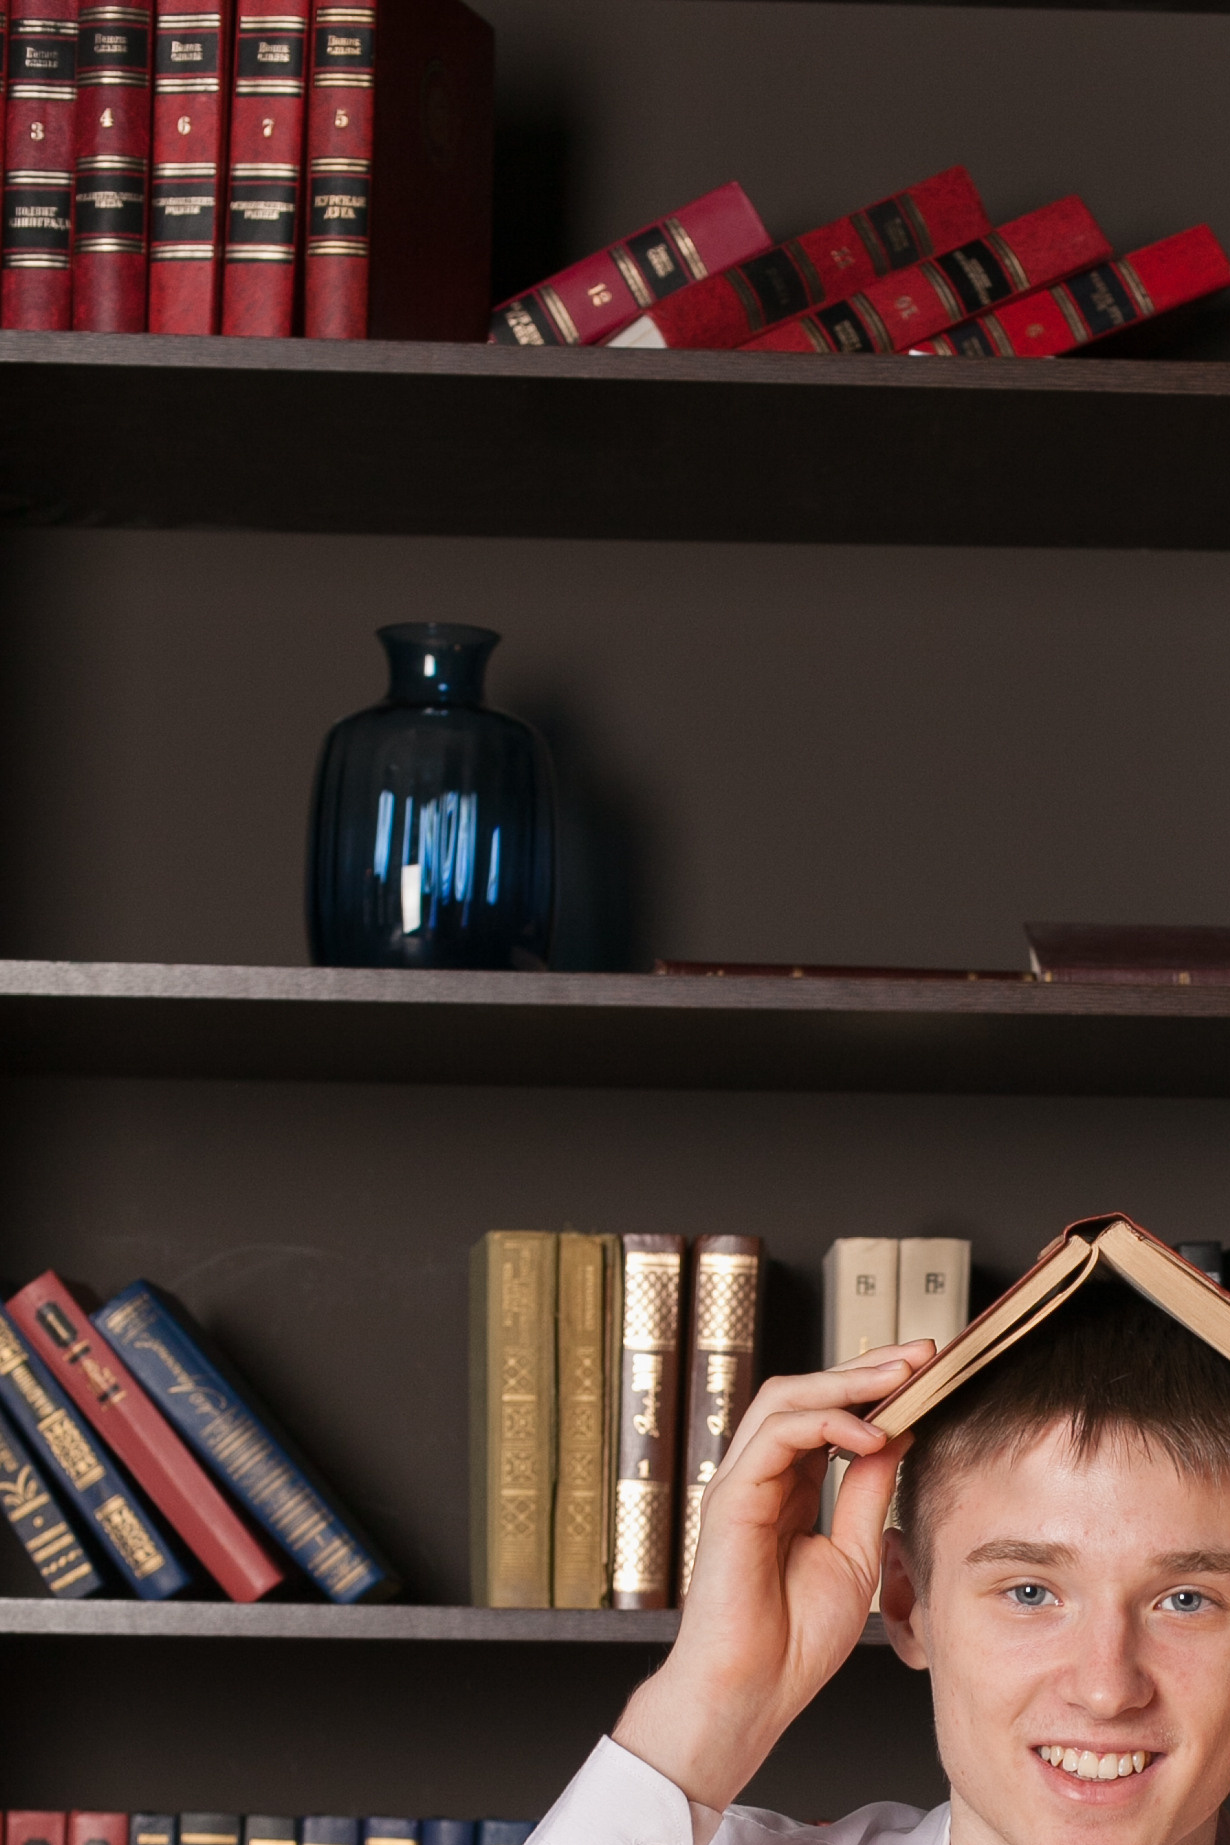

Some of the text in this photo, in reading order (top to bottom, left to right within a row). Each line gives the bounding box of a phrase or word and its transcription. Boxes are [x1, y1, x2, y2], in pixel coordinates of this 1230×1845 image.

[100, 107, 114, 128] 4
[177, 115, 192, 135] 6
[262, 118, 275, 137] 7
[334, 109, 348, 128] 5
[31, 122, 45, 140] 3
[638, 1458, 650, 1479] 1
[697, 1460, 718, 1483] 2
